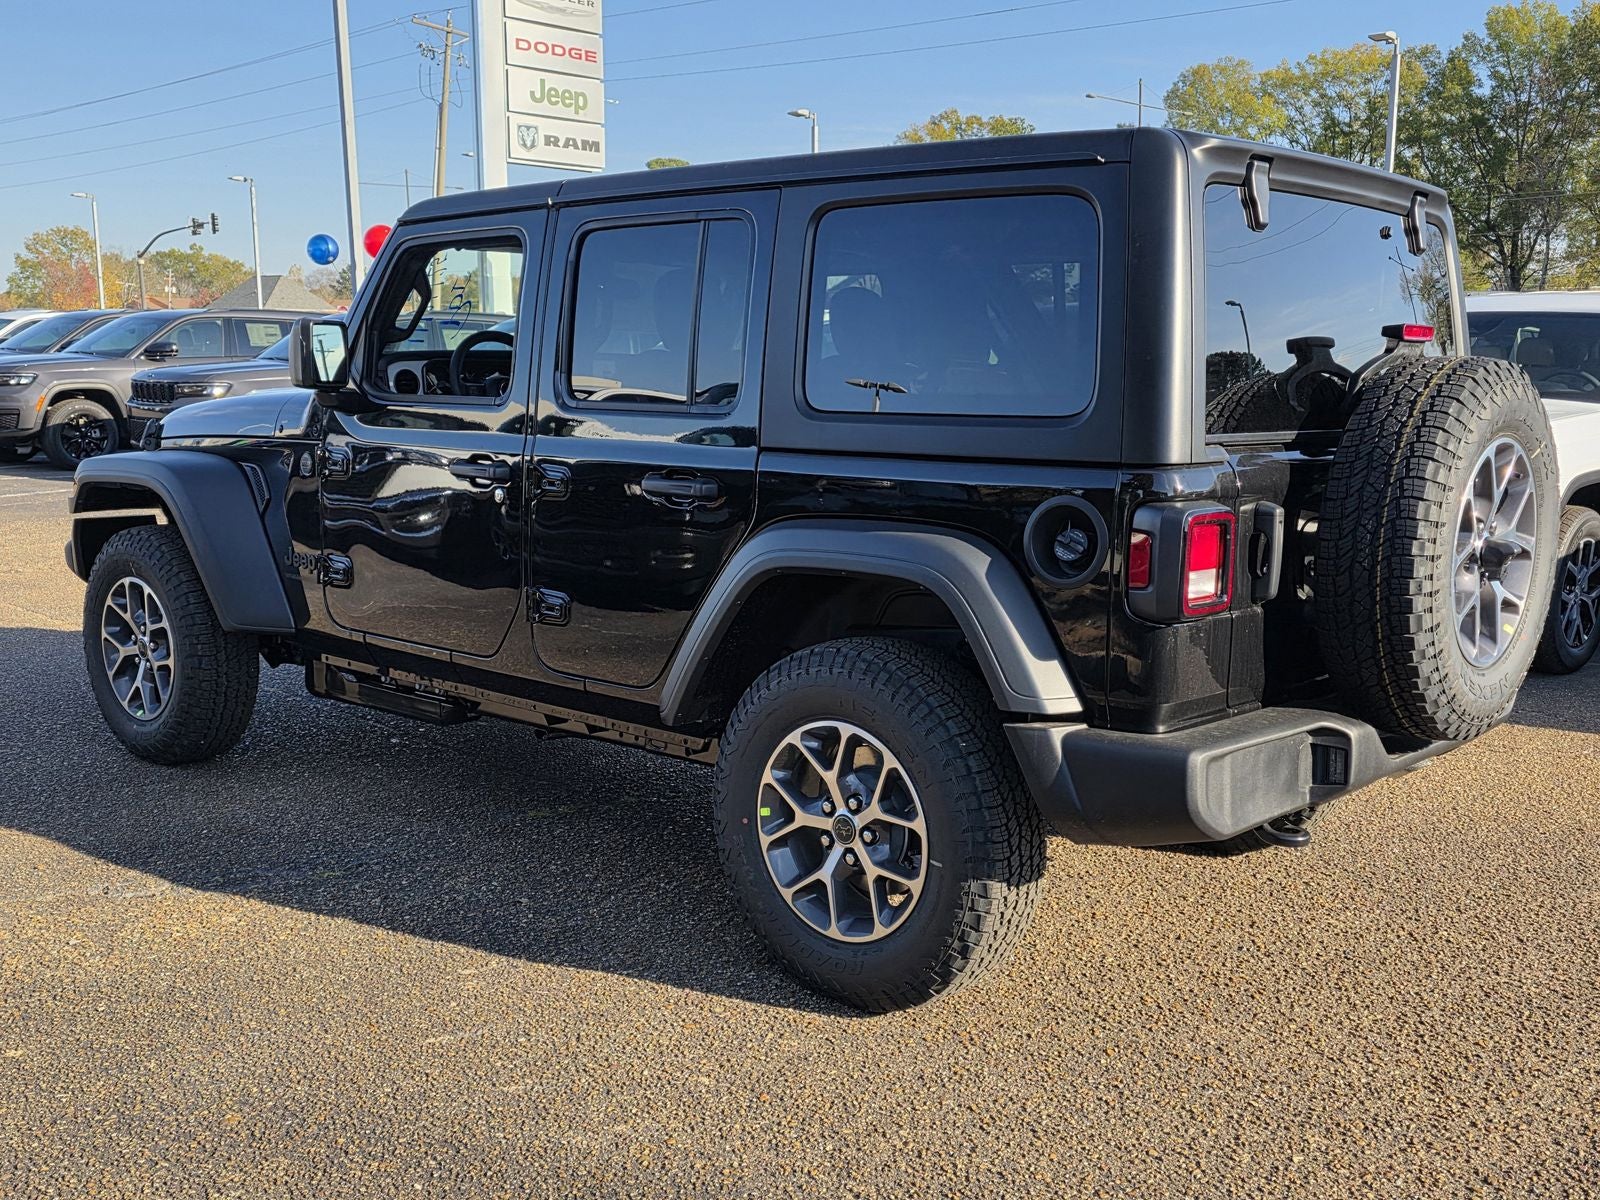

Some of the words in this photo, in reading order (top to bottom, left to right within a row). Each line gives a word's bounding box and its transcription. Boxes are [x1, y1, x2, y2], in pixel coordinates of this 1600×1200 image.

[515, 38, 598, 63] DODGE
[529, 78, 588, 115] Jeep
[543, 134, 600, 153] RAM
[284, 546, 317, 574] Jeep
